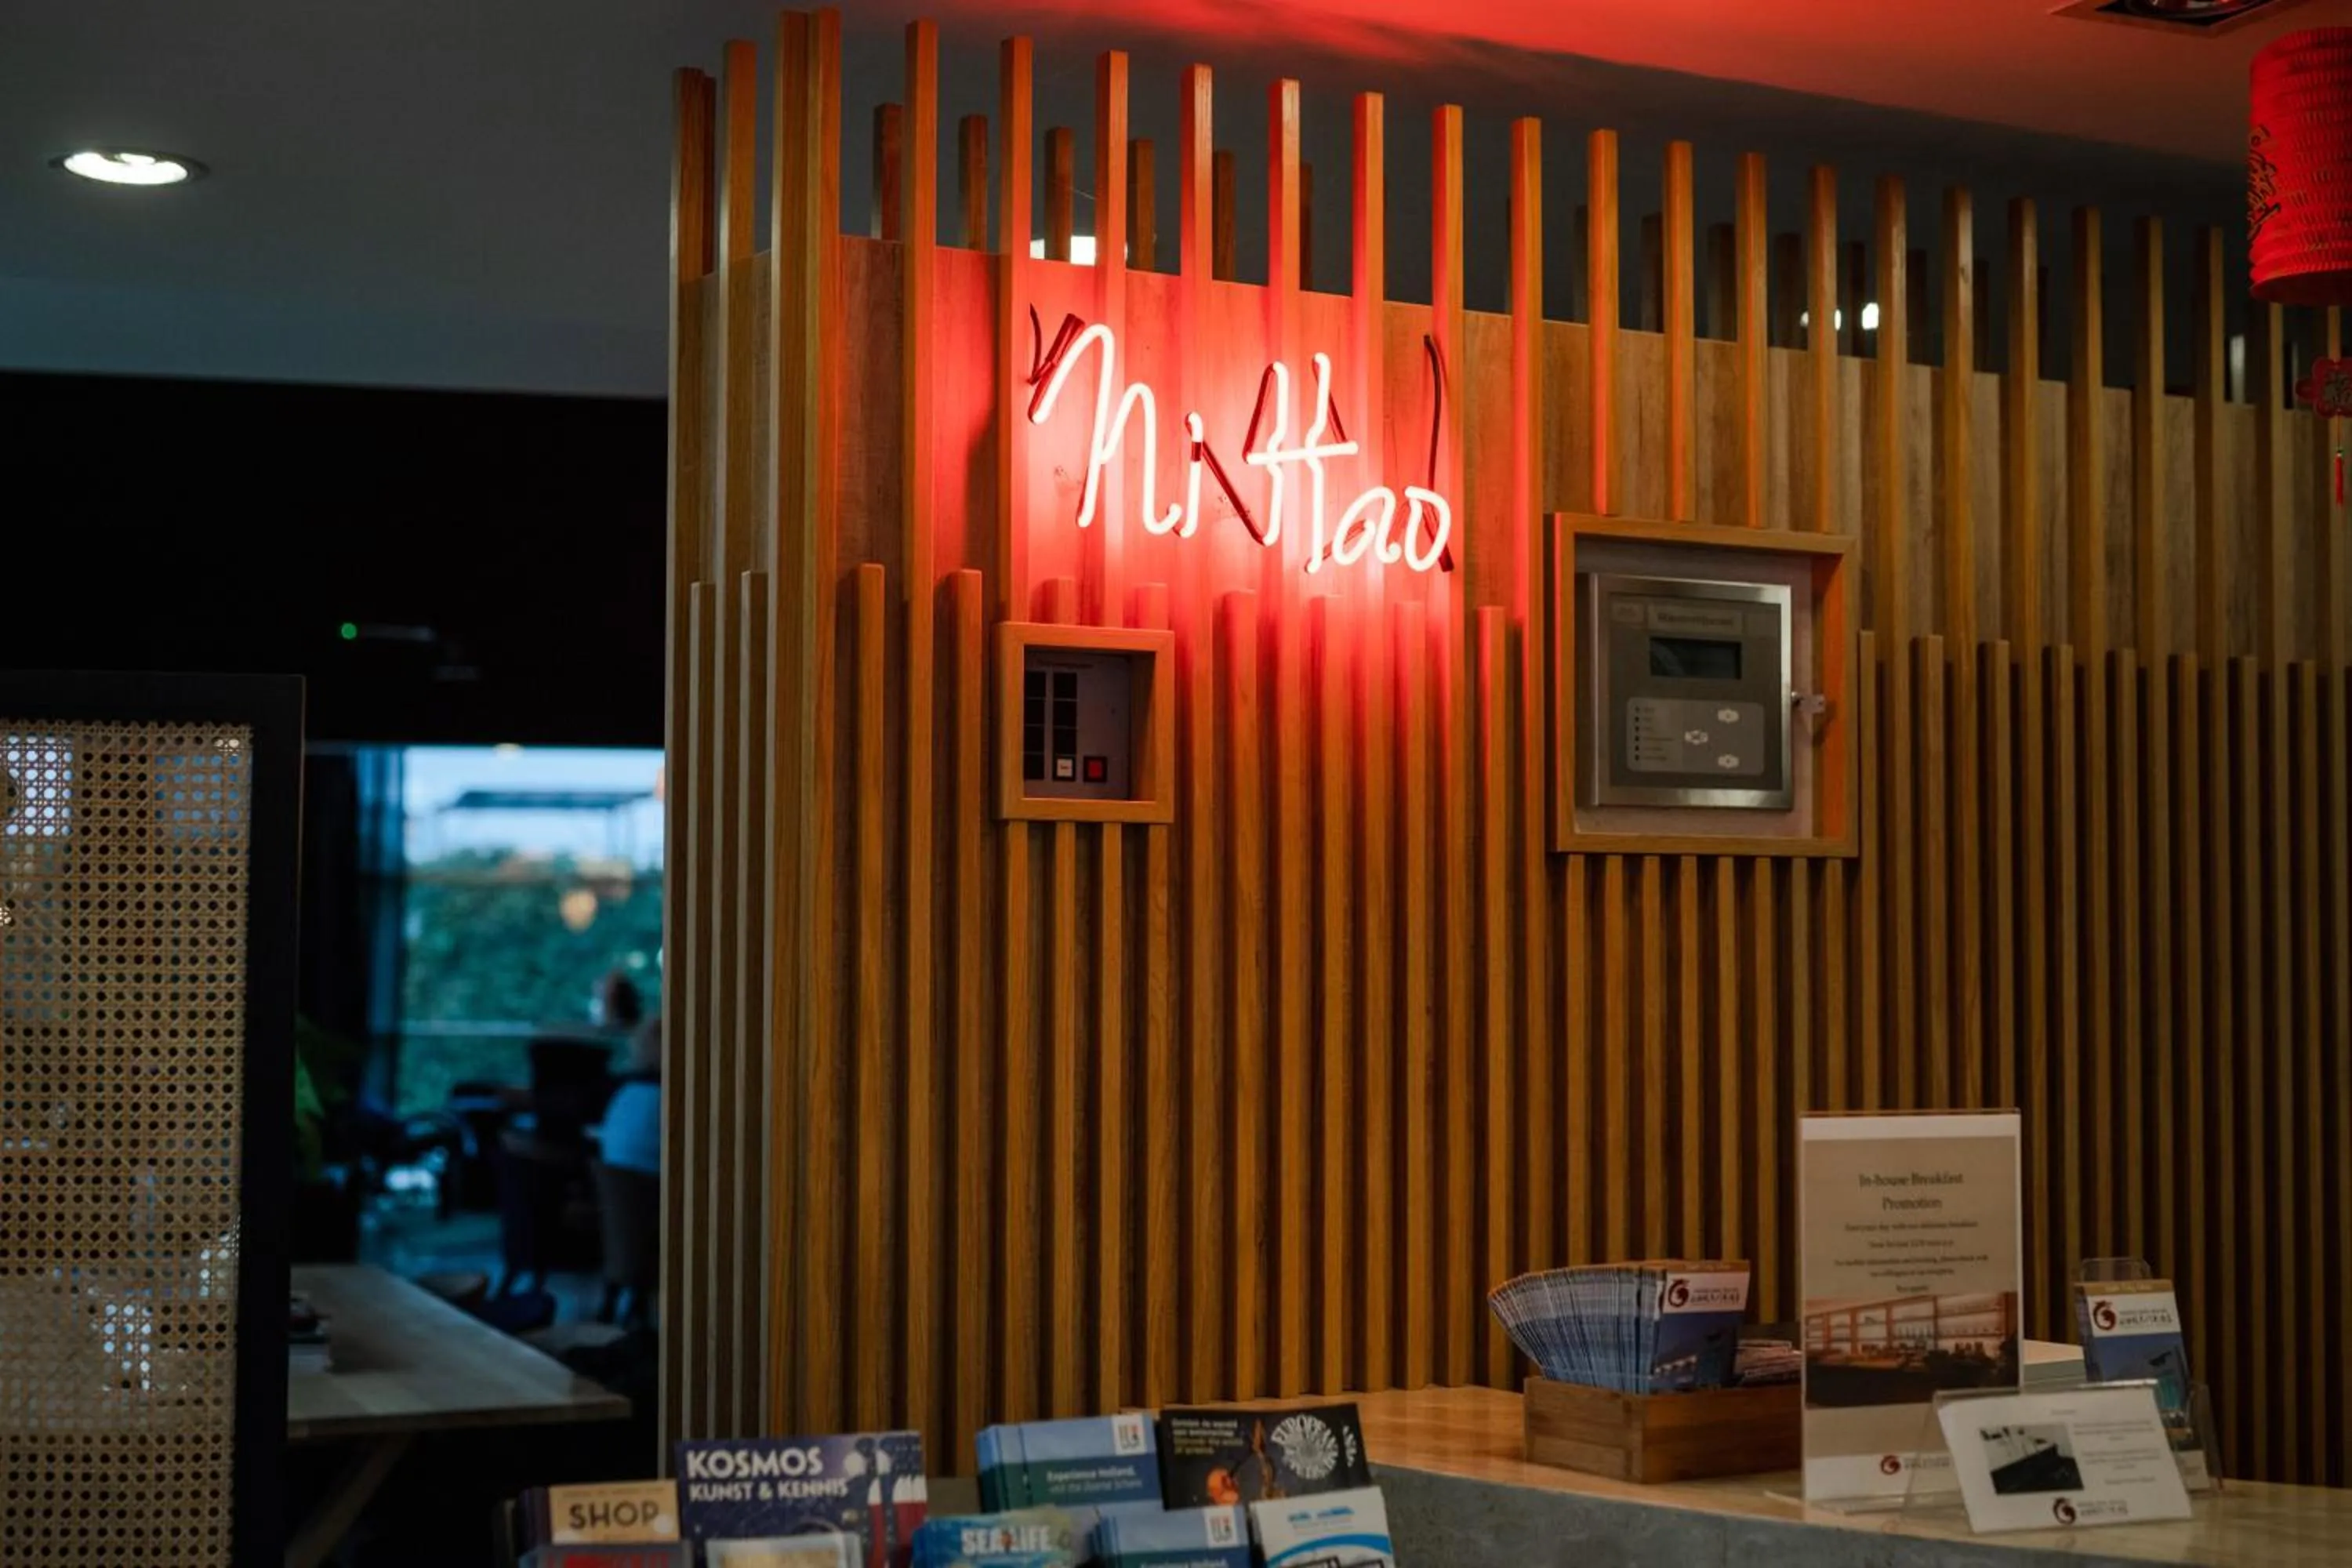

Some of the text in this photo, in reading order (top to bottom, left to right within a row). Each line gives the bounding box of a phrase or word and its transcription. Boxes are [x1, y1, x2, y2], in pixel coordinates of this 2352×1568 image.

[1882, 1196, 1943, 1211] Promotion
[686, 1446, 824, 1479] KOSMOS
[688, 1481, 754, 1503] KUNST
[758, 1481, 773, 1501] &
[777, 1477, 849, 1499] KENNIS
[568, 1501, 660, 1530] SHOP
[960, 1523, 1053, 1556] SEA LIFE
